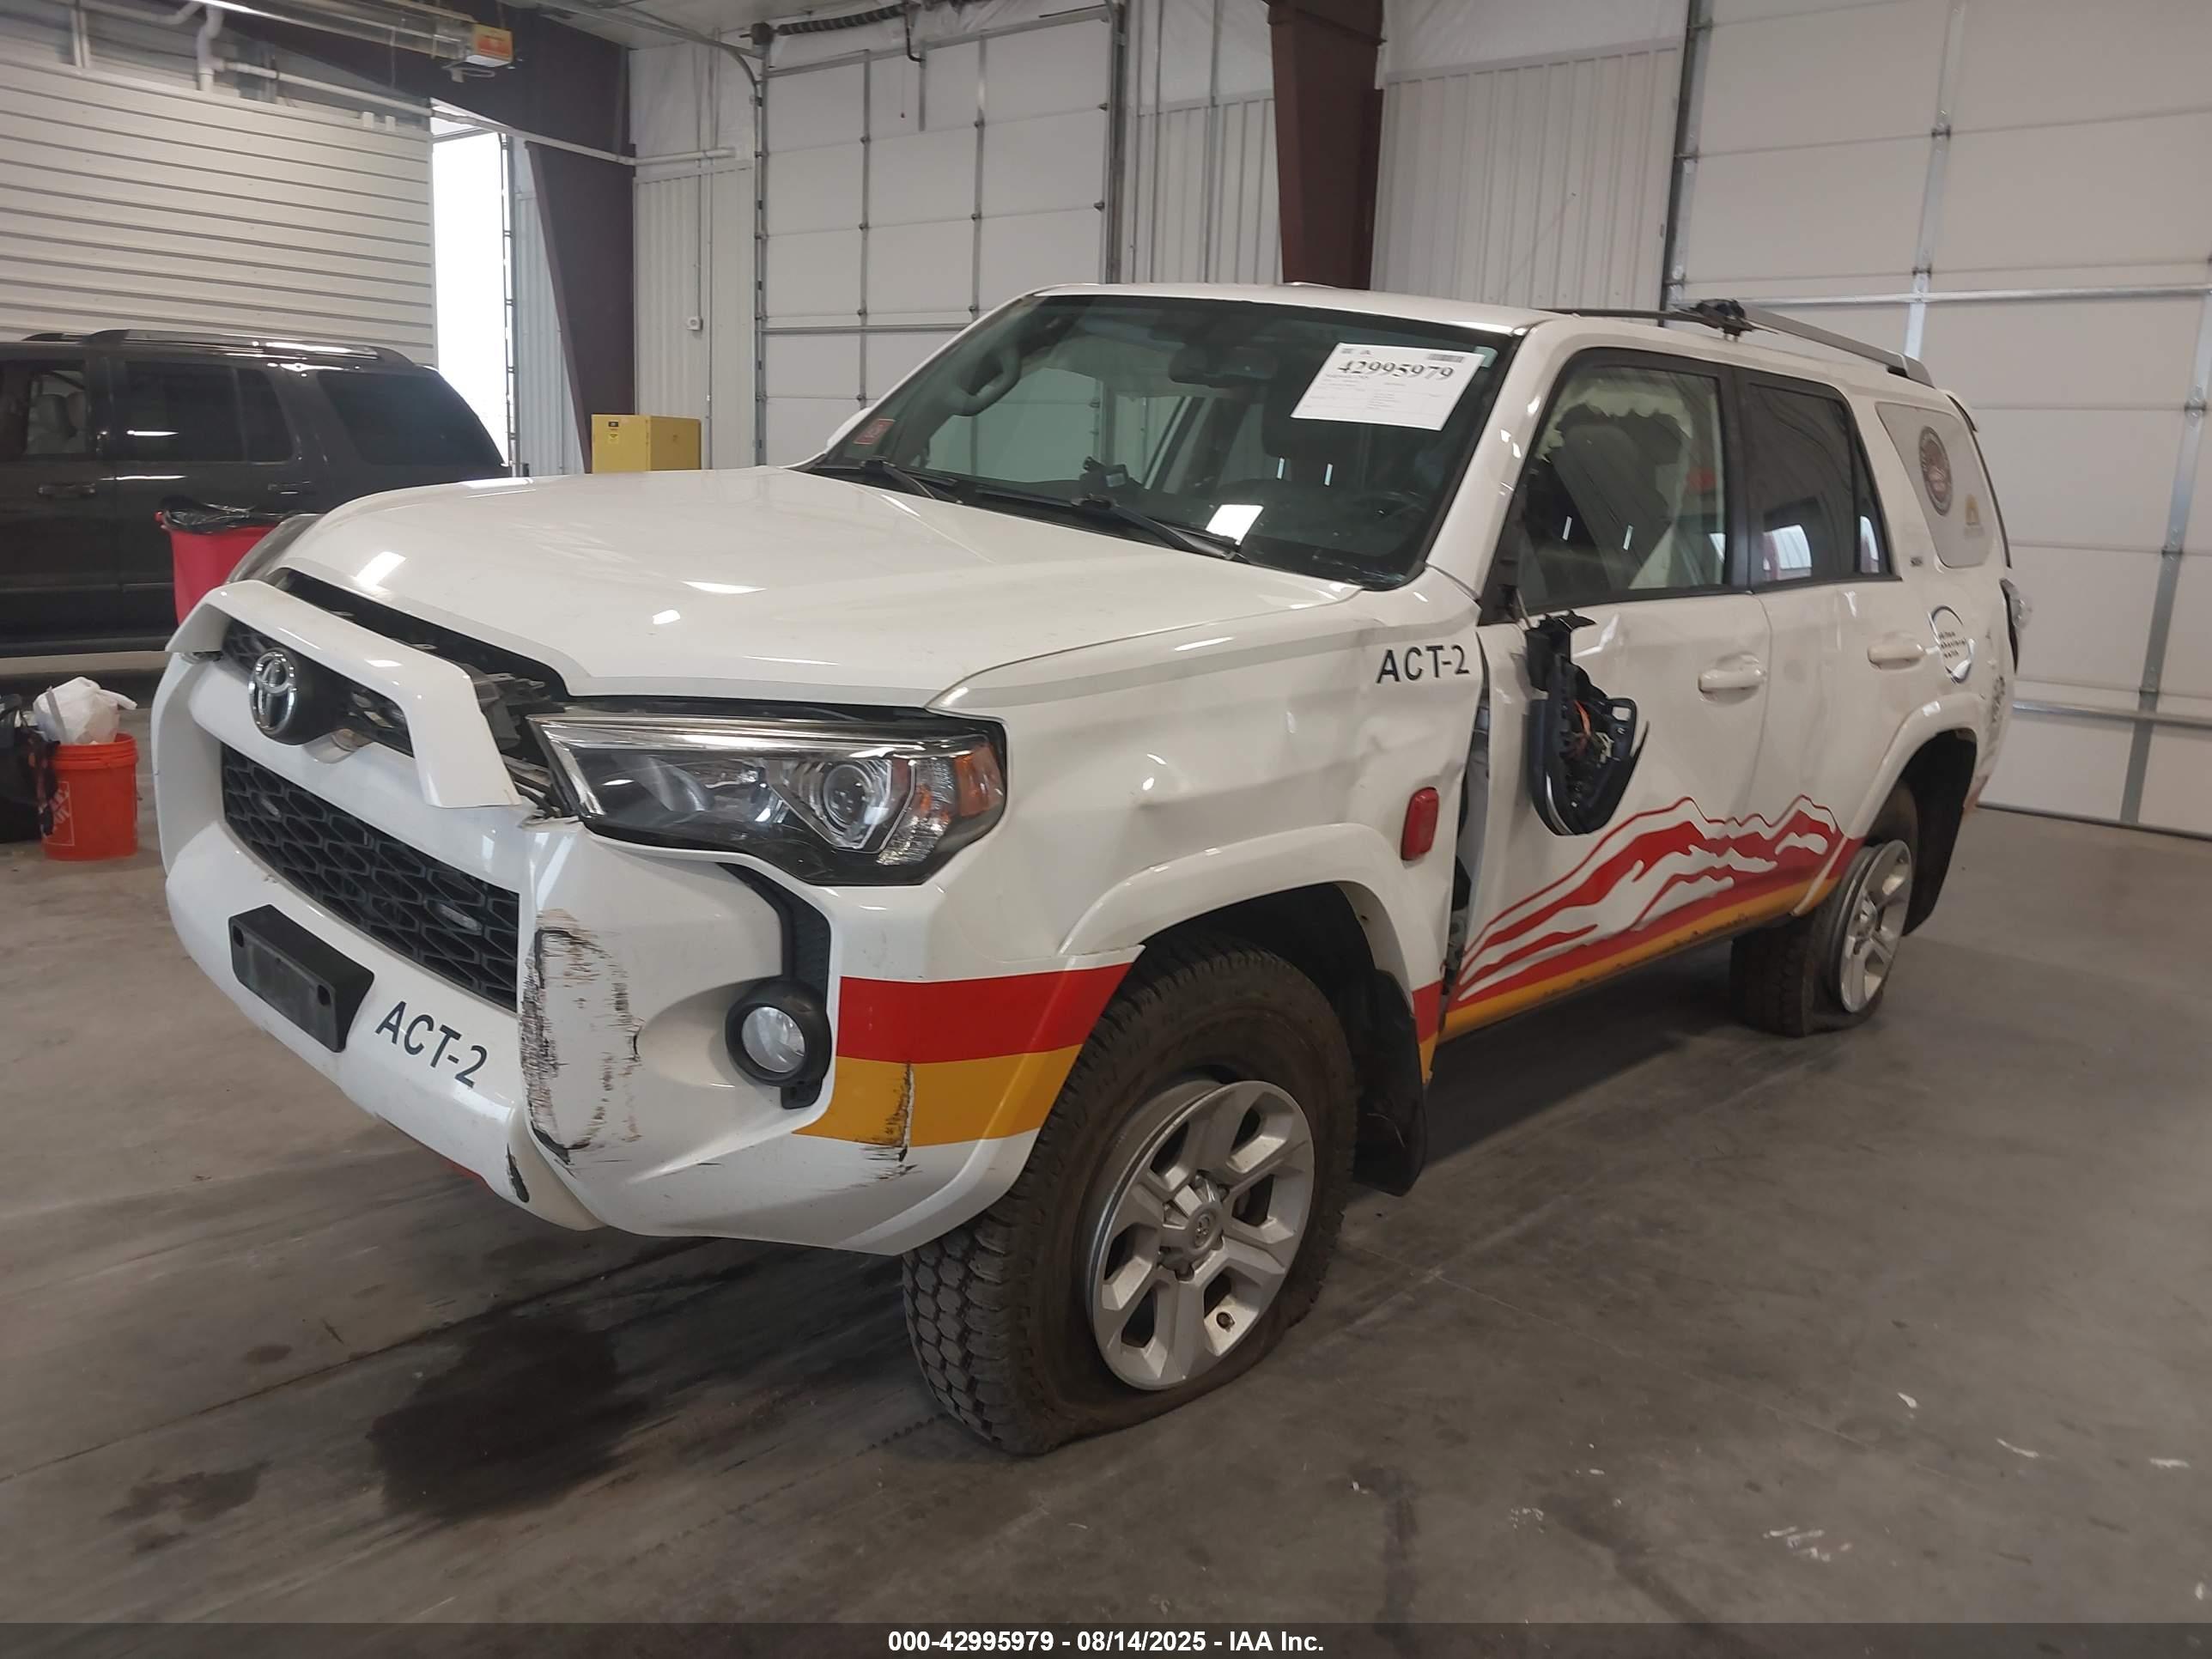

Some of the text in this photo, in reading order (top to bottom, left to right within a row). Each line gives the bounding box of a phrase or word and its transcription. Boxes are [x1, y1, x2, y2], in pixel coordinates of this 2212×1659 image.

[1338, 361, 1455, 381] 42995979
[1376, 644, 1470, 684] ACT-2
[374, 1000, 488, 1089] ACT-2
